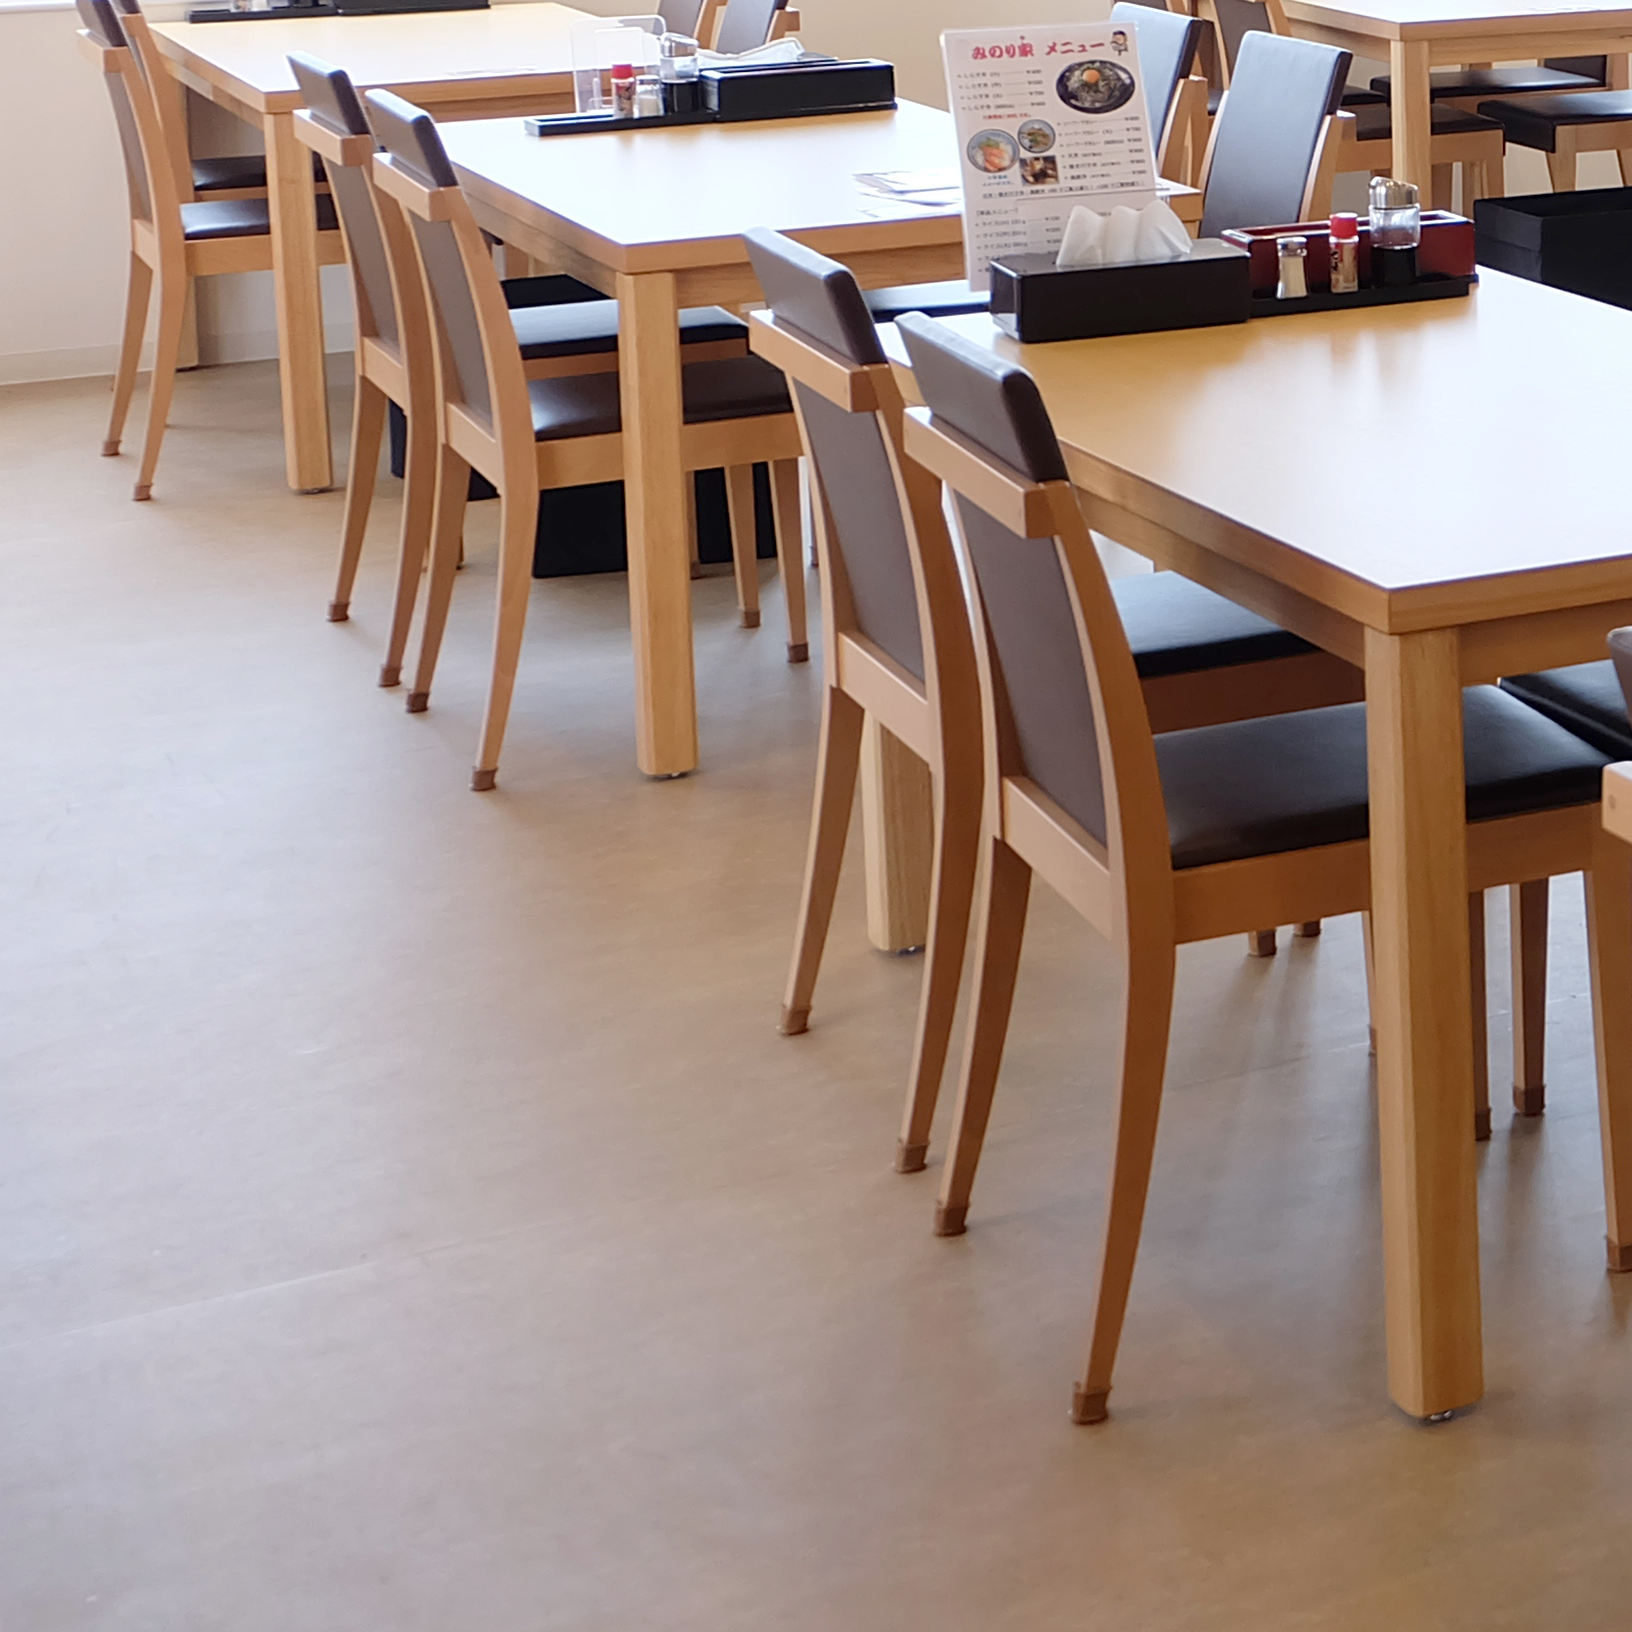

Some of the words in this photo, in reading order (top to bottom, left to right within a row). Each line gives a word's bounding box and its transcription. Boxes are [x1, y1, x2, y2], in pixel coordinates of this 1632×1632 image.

[971, 42, 1035, 60] みのり家
[1045, 41, 1106, 57] メニュー
